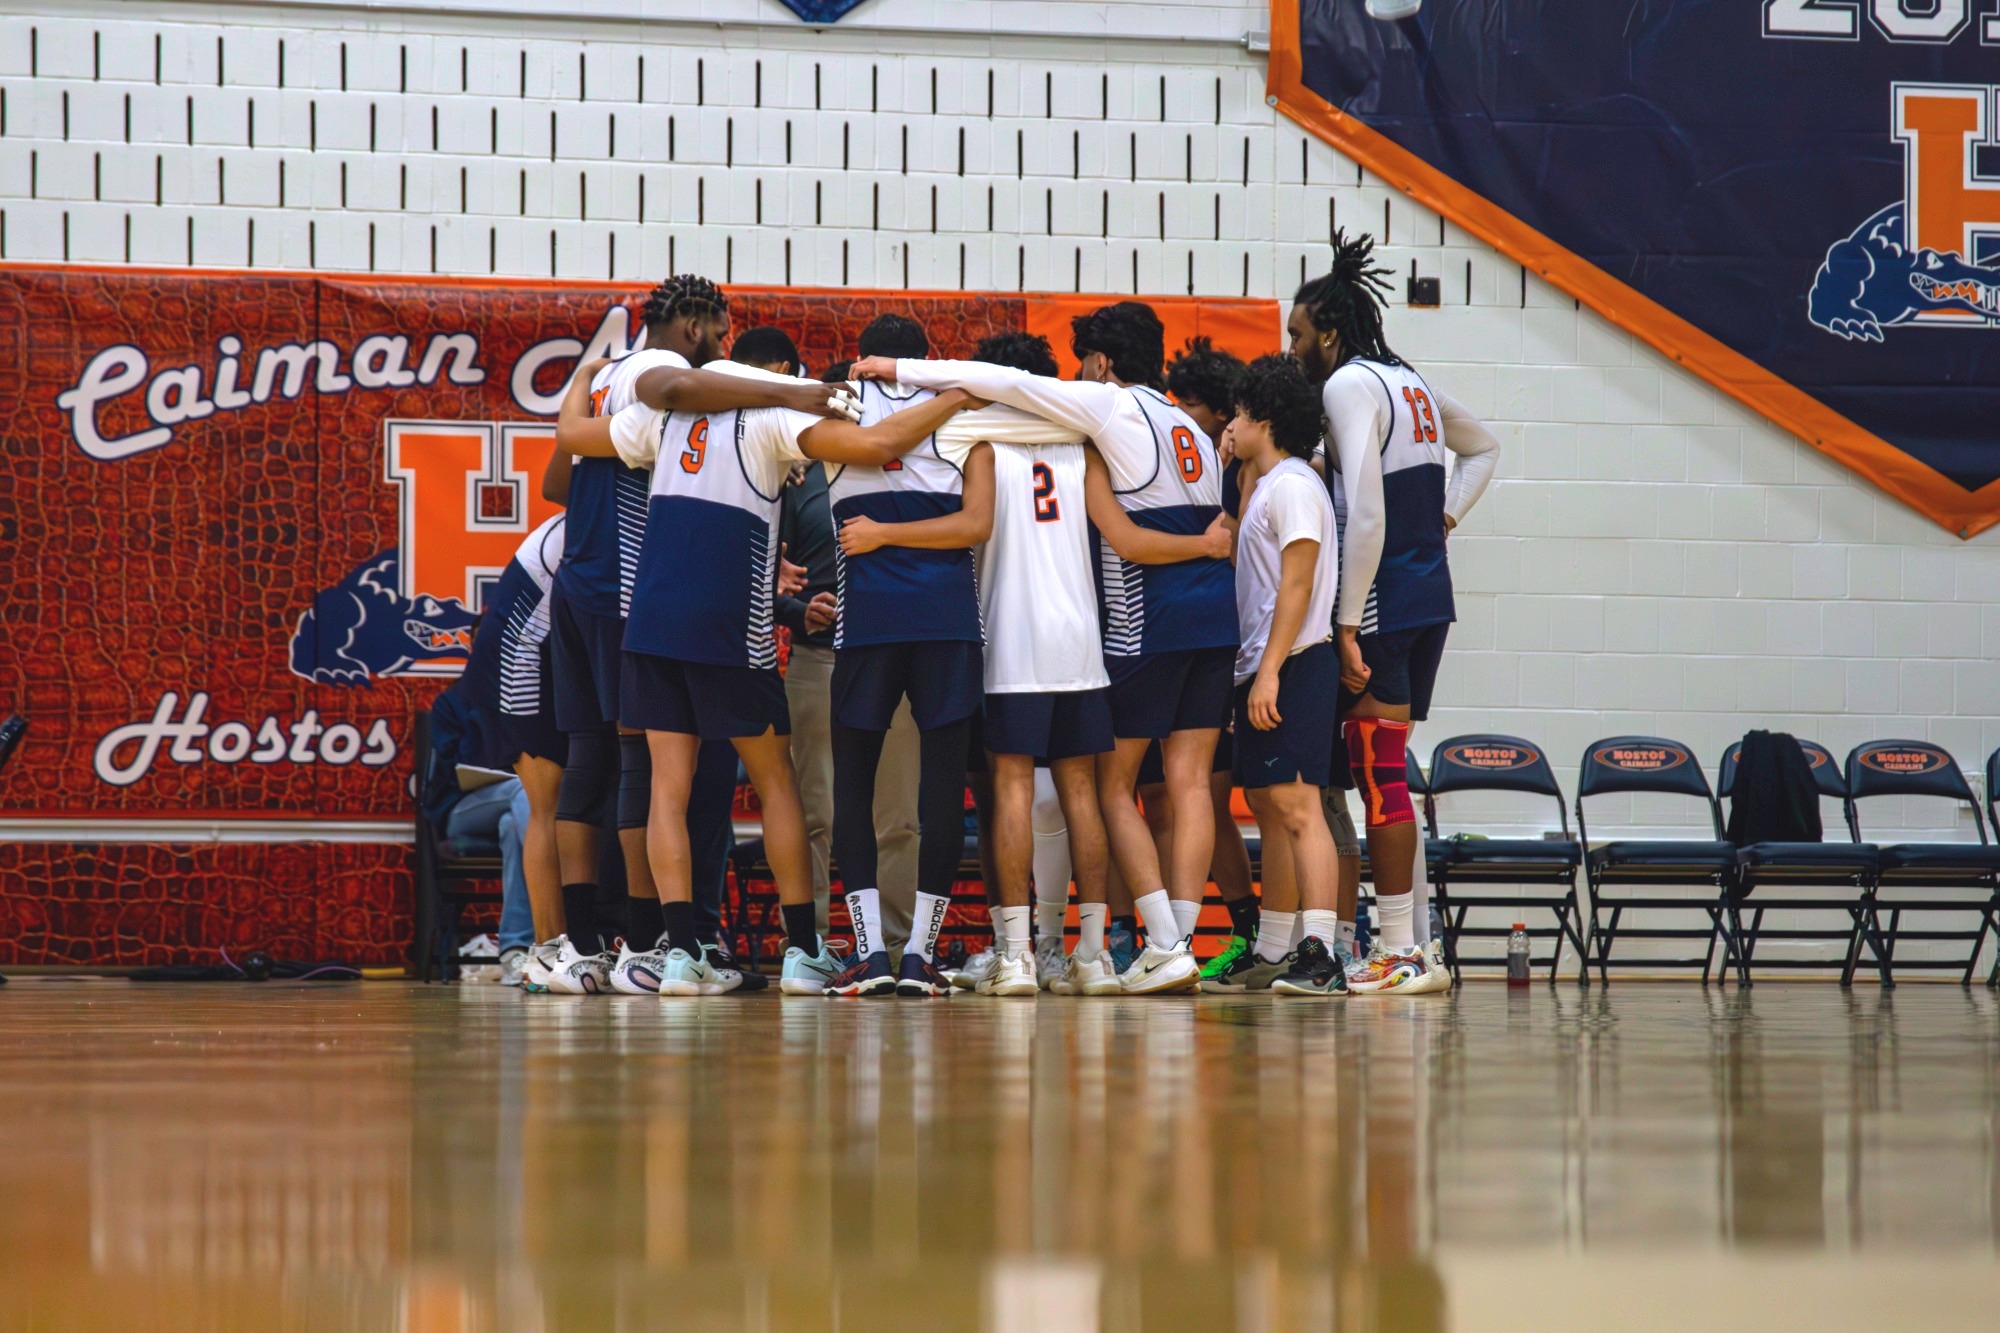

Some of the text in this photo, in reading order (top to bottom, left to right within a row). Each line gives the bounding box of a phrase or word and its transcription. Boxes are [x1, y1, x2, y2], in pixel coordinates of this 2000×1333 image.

[57, 332, 486, 461] Caiman
[1402, 386, 1437, 443] 13
[680, 417, 709, 475] 9
[1171, 425, 1203, 483] 8
[1033, 461, 1060, 522] 2
[93, 691, 397, 787] Hostos
[1613, 750, 1666, 761] HOSTOS
[852, 905, 869, 954] adidas
[928, 899, 946, 941] adidas
